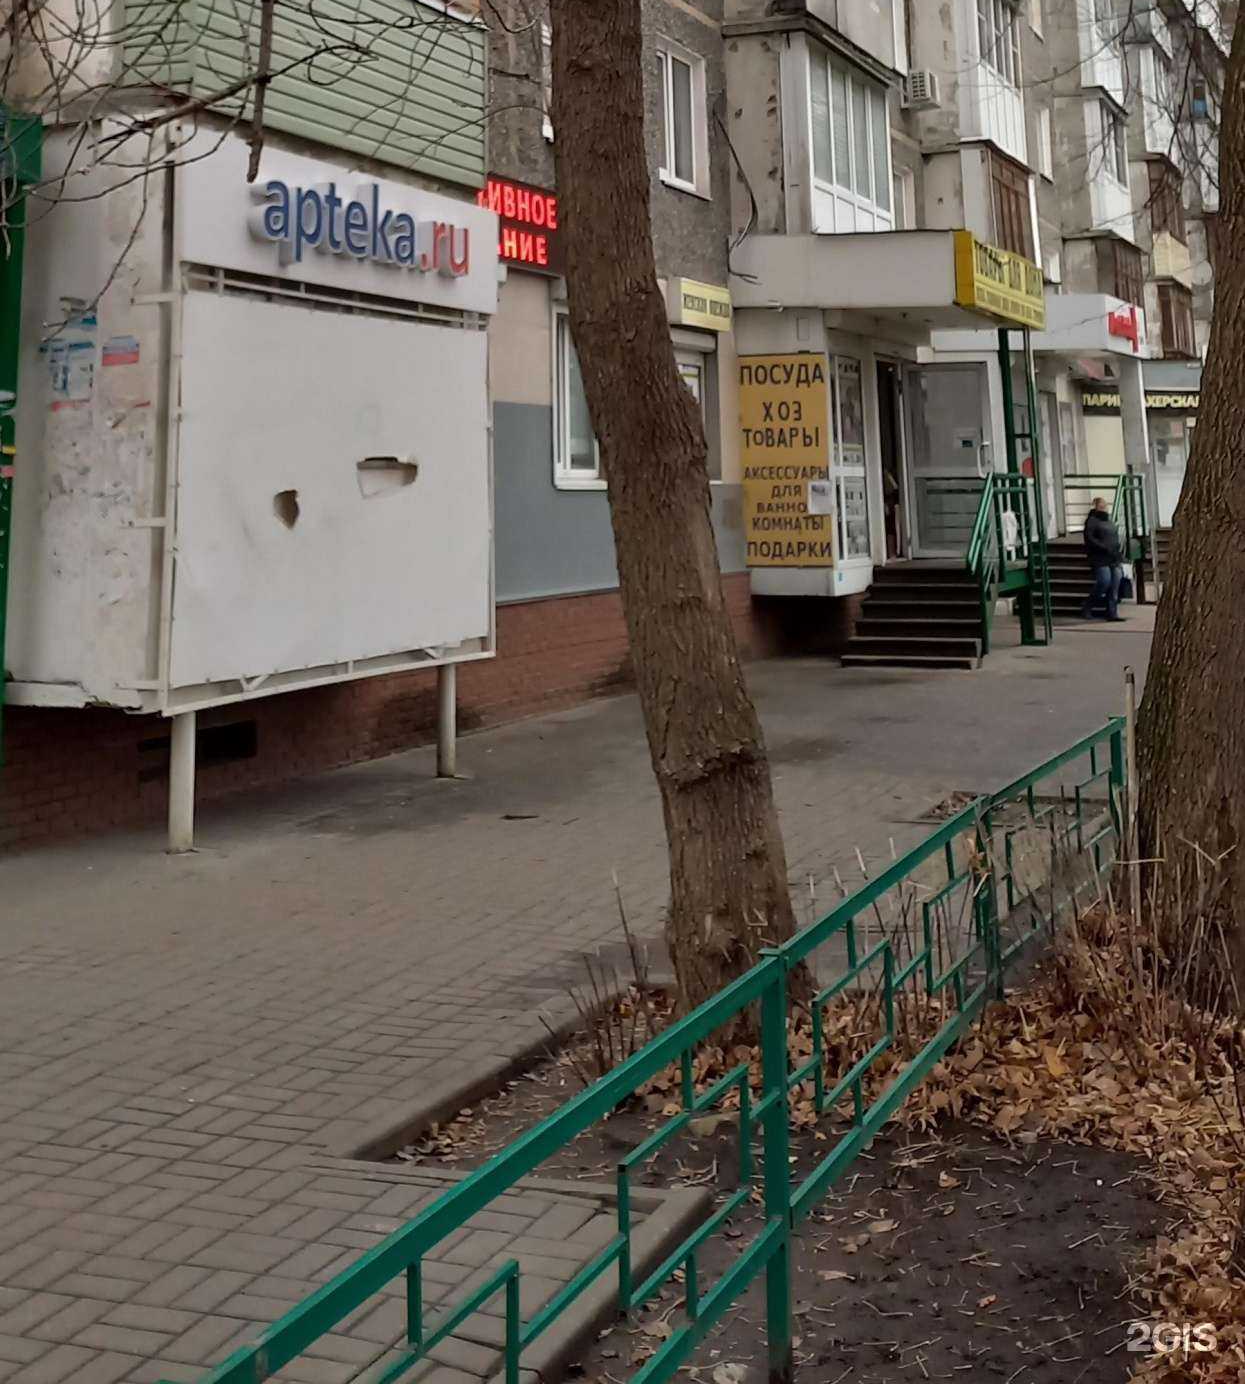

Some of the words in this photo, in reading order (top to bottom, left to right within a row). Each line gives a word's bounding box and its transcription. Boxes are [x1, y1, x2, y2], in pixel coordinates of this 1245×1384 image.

[264, 180, 470, 275] apteka.ru
[497, 228, 548, 265] НИЕ
[740, 363, 825, 388] ПОСУДА
[762, 401, 803, 422] ХОЗ
[742, 427, 820, 449] ТОВАРЫ
[745, 465, 829, 480] АКСЕССУАРЫ
[771, 485, 802, 499] ДЛЯ
[757, 502, 809, 513] ВАННО
[752, 516, 824, 531] КОМНАТЫ
[747, 541, 832, 560] ПОДАРКИ
